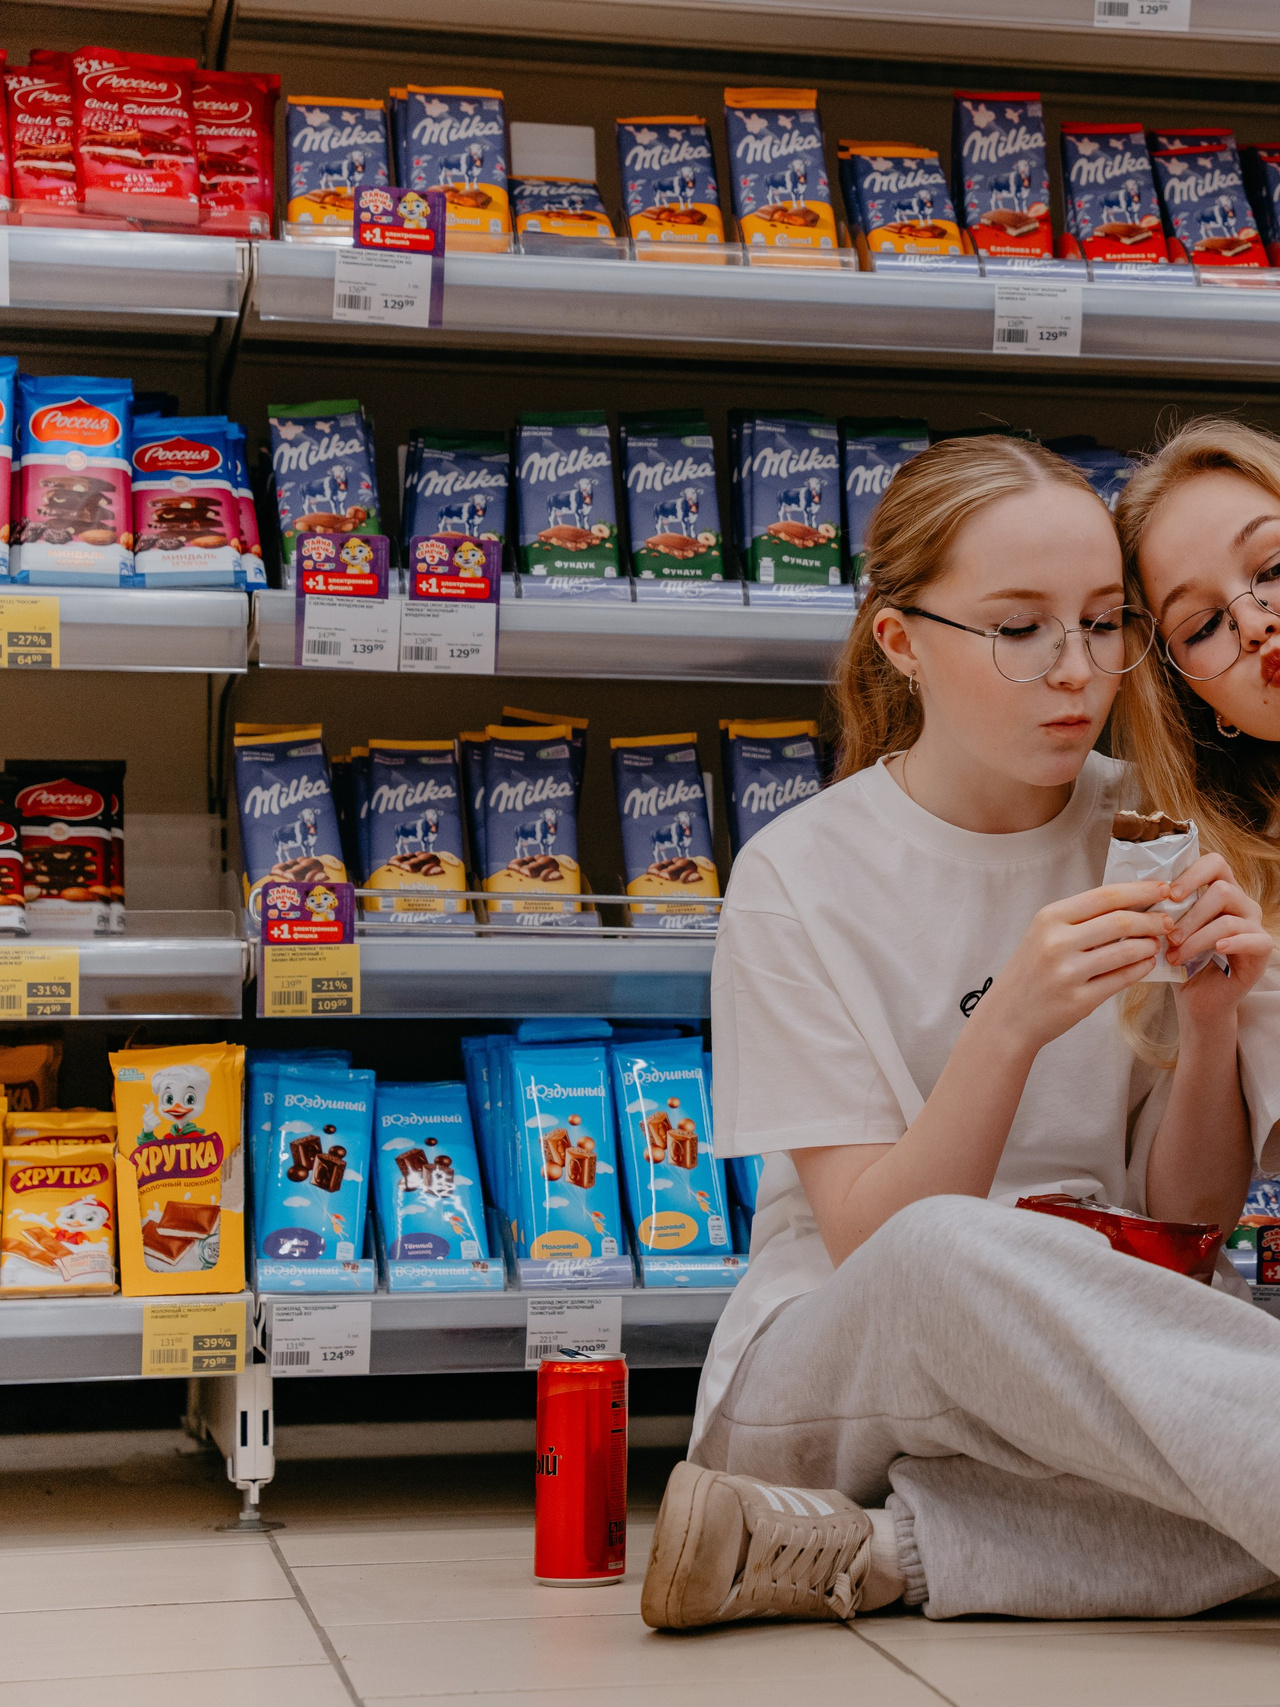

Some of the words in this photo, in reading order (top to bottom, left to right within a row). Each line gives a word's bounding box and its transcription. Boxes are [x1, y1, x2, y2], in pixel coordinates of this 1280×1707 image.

[85, 98, 120, 112] Gold
[292, 126, 387, 153] Milka
[411, 115, 503, 146] Milka
[625, 142, 712, 171] Milka
[735, 130, 821, 164] Milka
[962, 127, 1046, 163] Milka
[863, 170, 946, 193] Milka
[1070, 152, 1152, 186] Milka
[1164, 170, 1241, 205] Milka
[363, 227, 383, 243] +1
[42, 410, 109, 432] Россия
[144, 447, 210, 464] Россия
[273, 434, 365, 474] Milka
[520, 446, 612, 485] Milka
[752, 446, 840, 479] Milka
[416, 469, 509, 497] Milka
[627, 457, 716, 494] Milka
[305, 574, 326, 591] +1
[328, 578, 373, 586] электронная
[419, 577, 439, 593] +1
[440, 587, 466, 595] фишка
[12, 634, 46, 645] -27%
[27, 788, 93, 806] Россия
[244, 774, 331, 819] Milka
[371, 780, 457, 818] Milka
[490, 775, 574, 813] Milka
[624, 780, 704, 819] Milka
[742, 774, 822, 815] Milka
[271, 923, 291, 939] +1
[32, 985, 66, 996] -31%
[316, 980, 348, 990] -21%
[134, 1140, 218, 1178] ХРУТКА
[16, 1166, 102, 1189] ХРУТКА
[140, 1180, 182, 1196] молочный
[184, 1176, 220, 1188] шоколад
[198, 1337, 232, 1348] -39%
